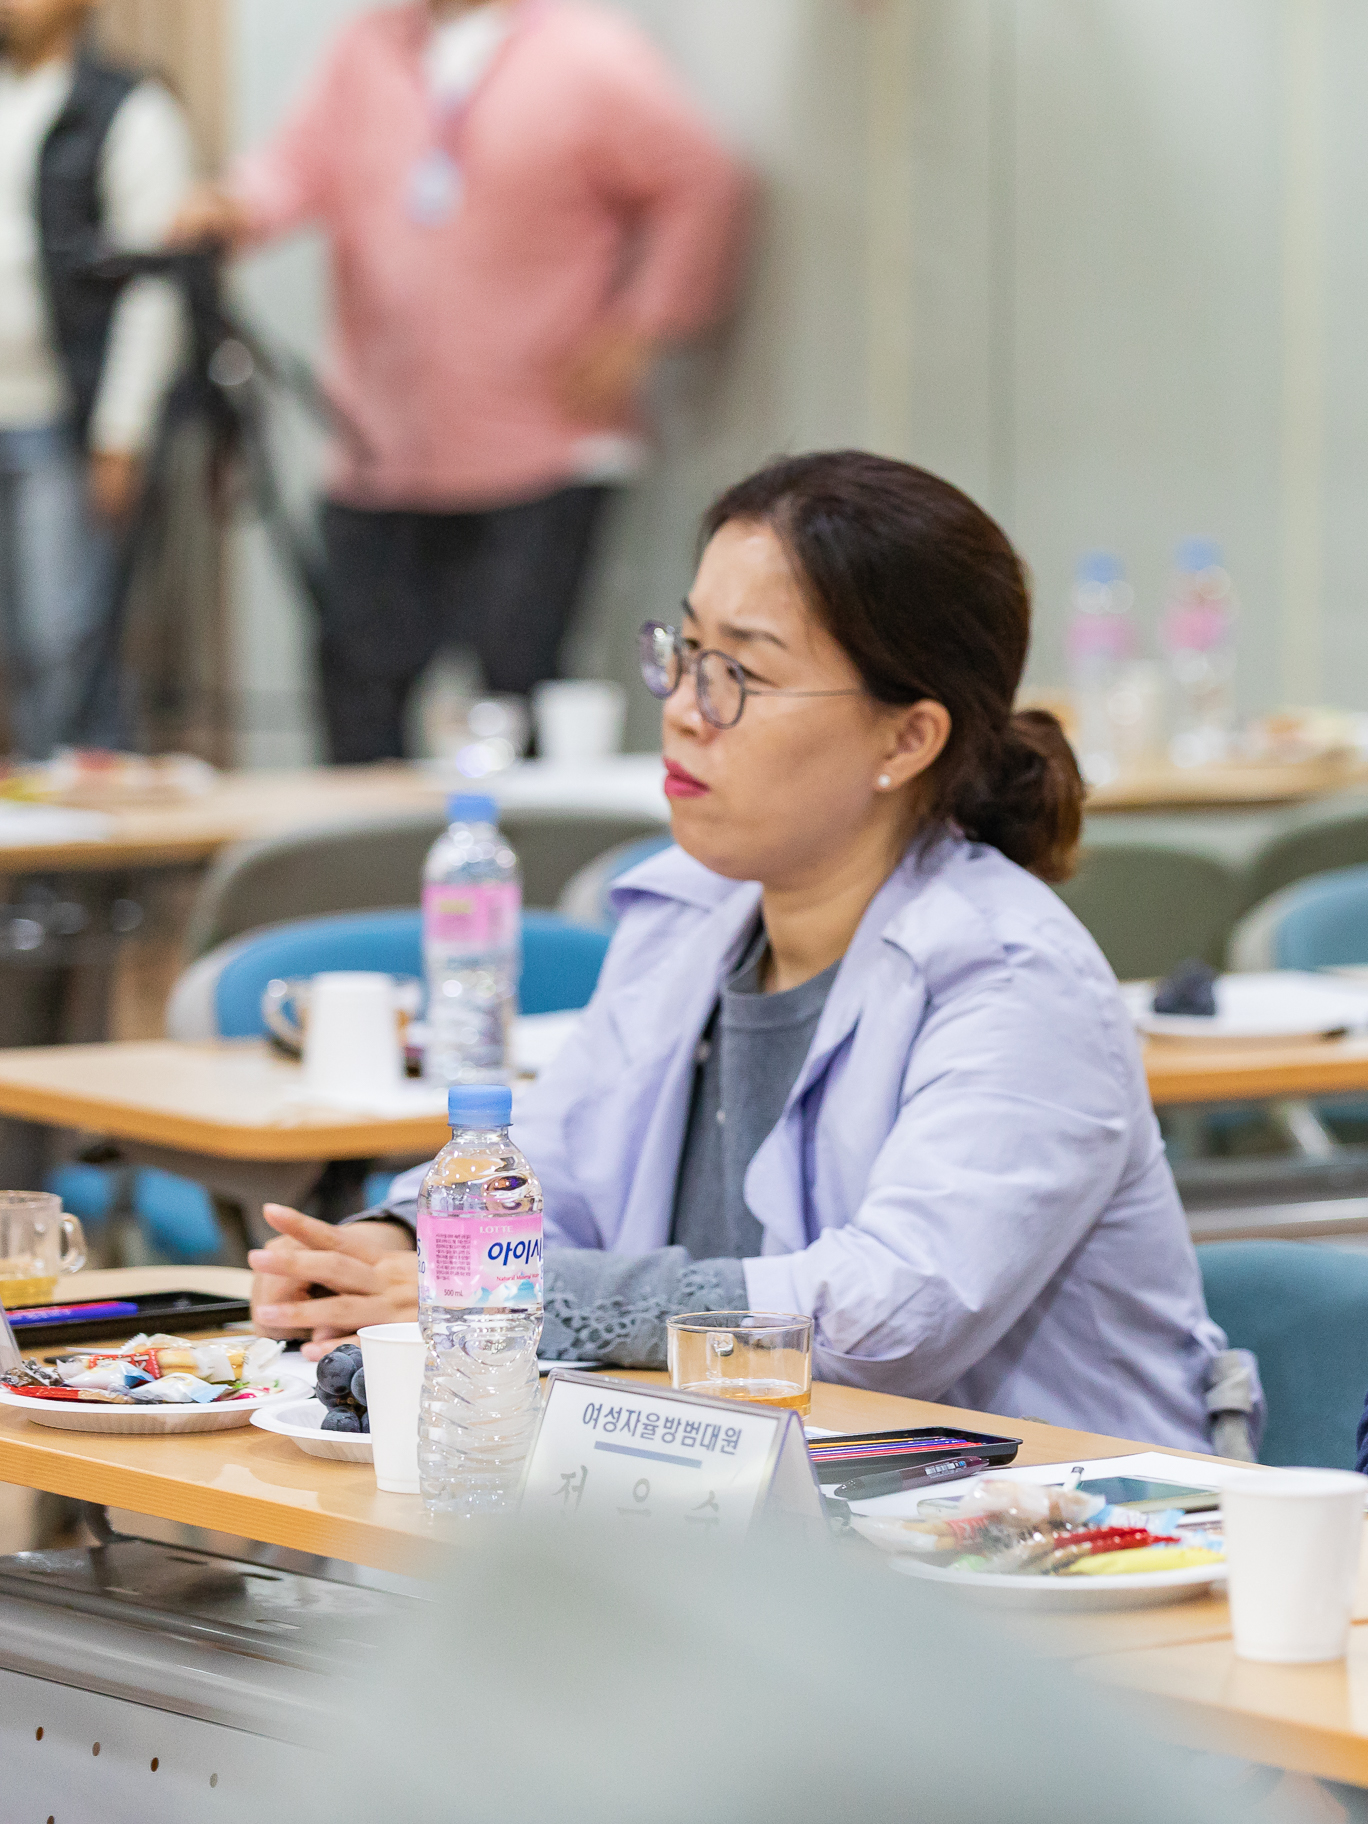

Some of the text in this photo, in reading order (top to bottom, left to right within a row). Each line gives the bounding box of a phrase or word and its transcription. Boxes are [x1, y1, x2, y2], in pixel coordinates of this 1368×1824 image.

[479, 1225, 513, 1234] LOTTE
[443, 1289, 455, 1297] 500
[582, 1402, 743, 1456] 여성자율방범대원
